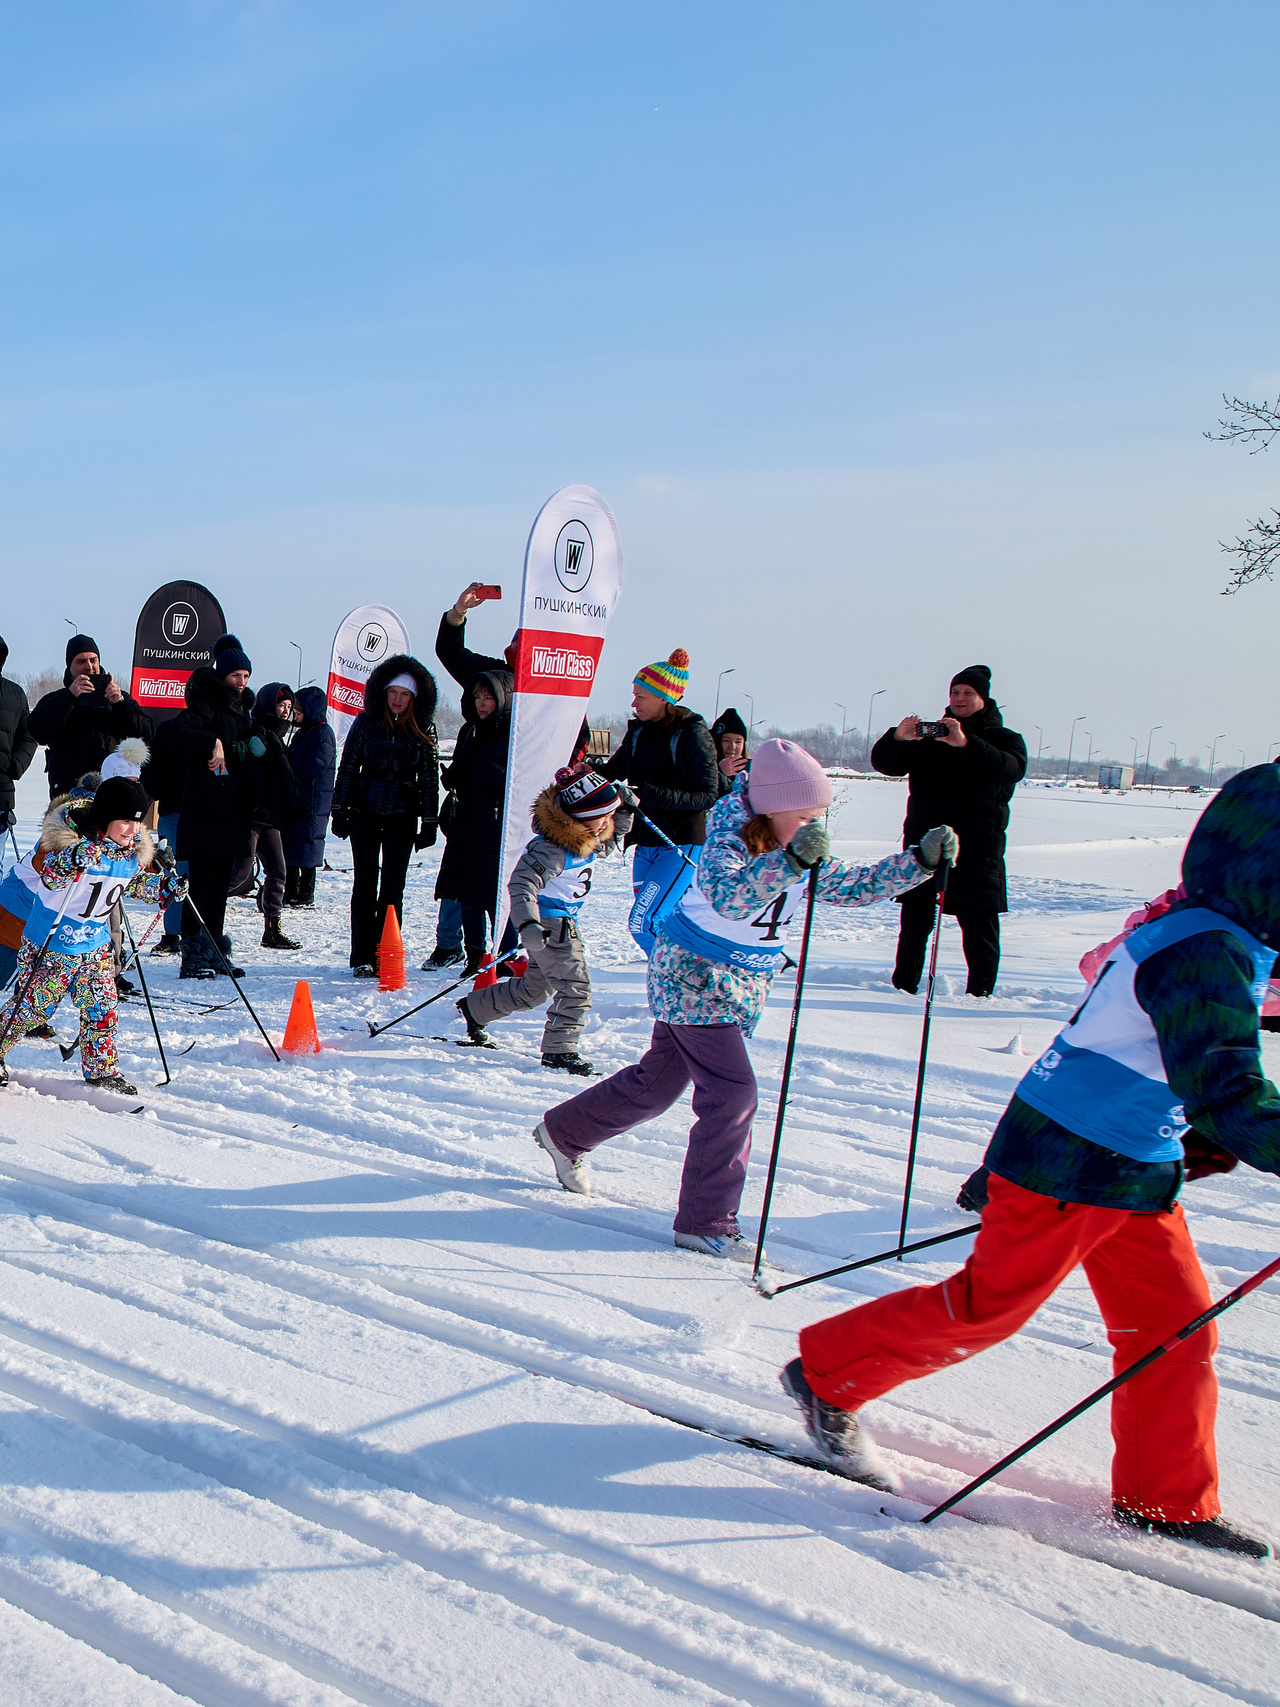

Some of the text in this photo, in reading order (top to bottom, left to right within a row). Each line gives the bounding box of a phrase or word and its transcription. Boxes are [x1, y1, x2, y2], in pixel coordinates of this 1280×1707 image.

[534, 596, 607, 619] ПУШКИНСКИЙ
[143, 648, 211, 661] ПУШКИНСКИЙ
[337, 655, 372, 674] ПУШКИН
[533, 650, 592, 678] World Class
[140, 680, 186, 697] World Clas
[348, 686, 365, 707] Clas
[561, 780, 587, 805] HEY
[573, 868, 593, 899] 3
[78, 881, 125, 919] 19
[630, 883, 658, 933] World Class
